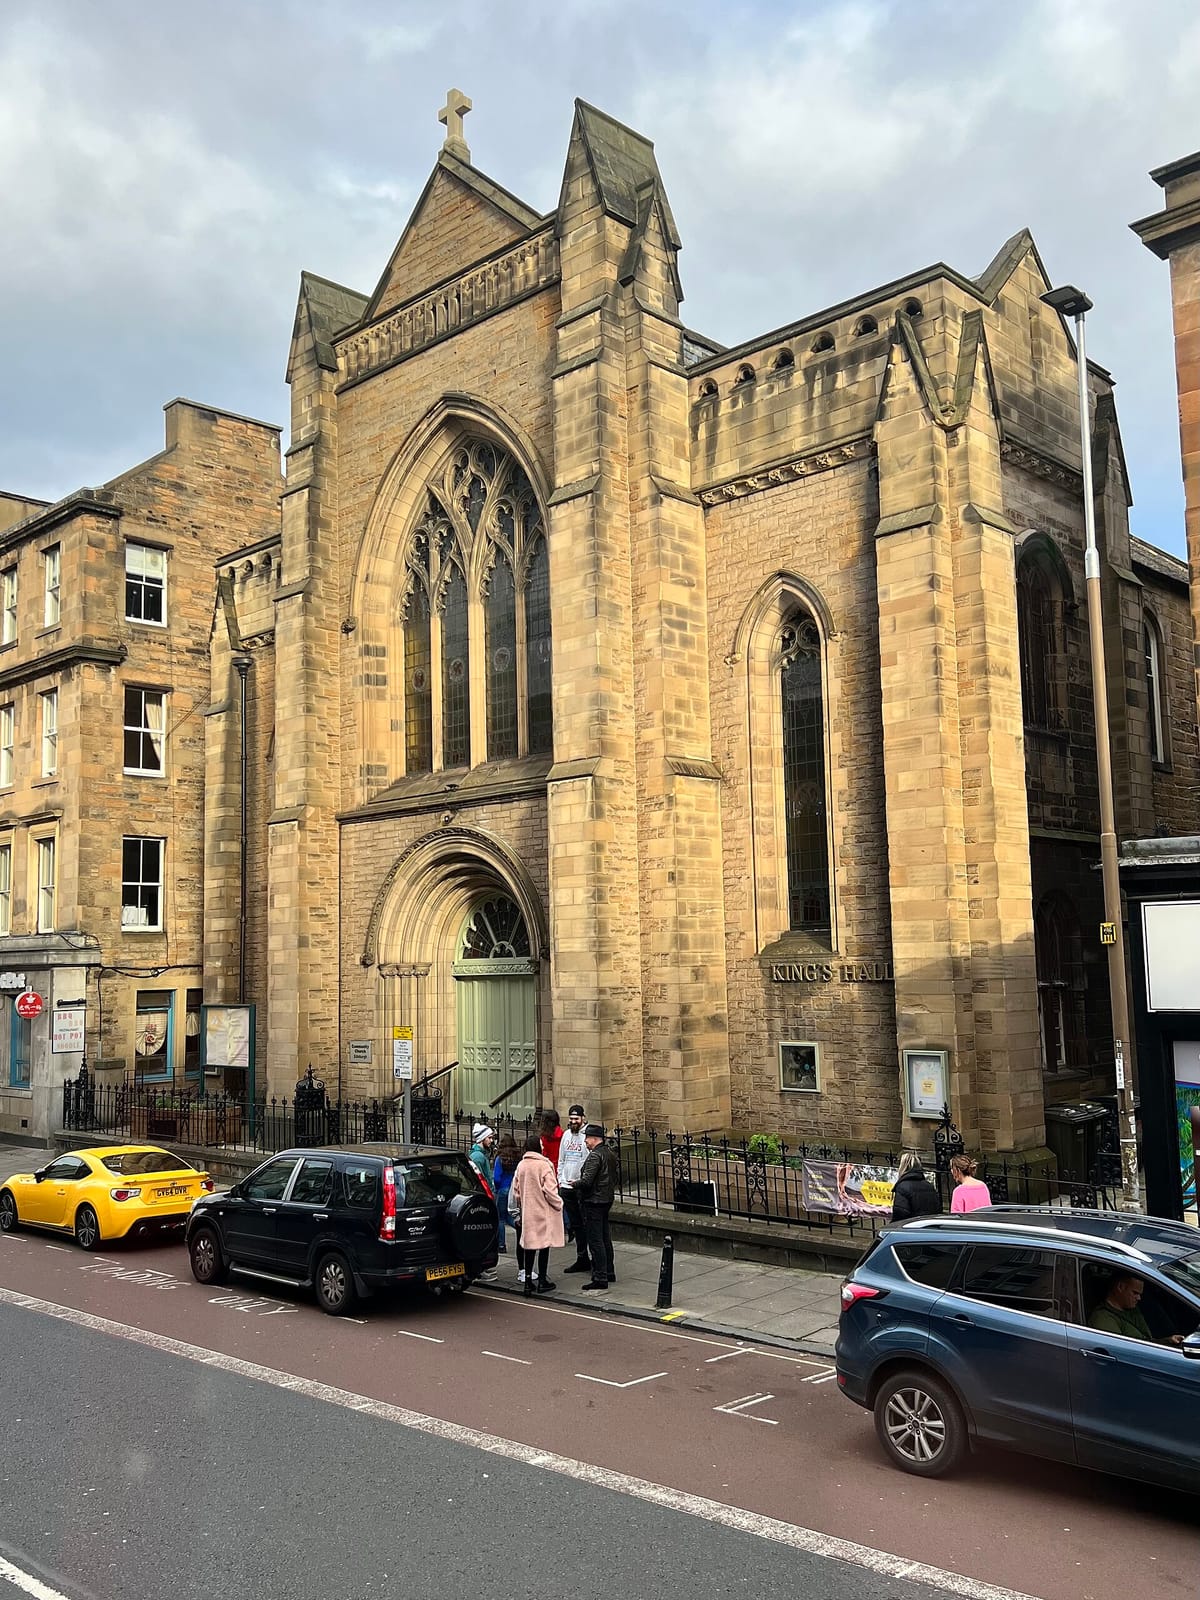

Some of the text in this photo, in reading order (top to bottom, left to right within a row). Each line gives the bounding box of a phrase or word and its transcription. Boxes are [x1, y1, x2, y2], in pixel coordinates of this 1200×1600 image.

[772, 962, 895, 982] KING'S HALL
[69, 1031, 83, 1040] POT
[463, 1223, 493, 1231] HONDA
[77, 1263, 192, 1290] LOADING
